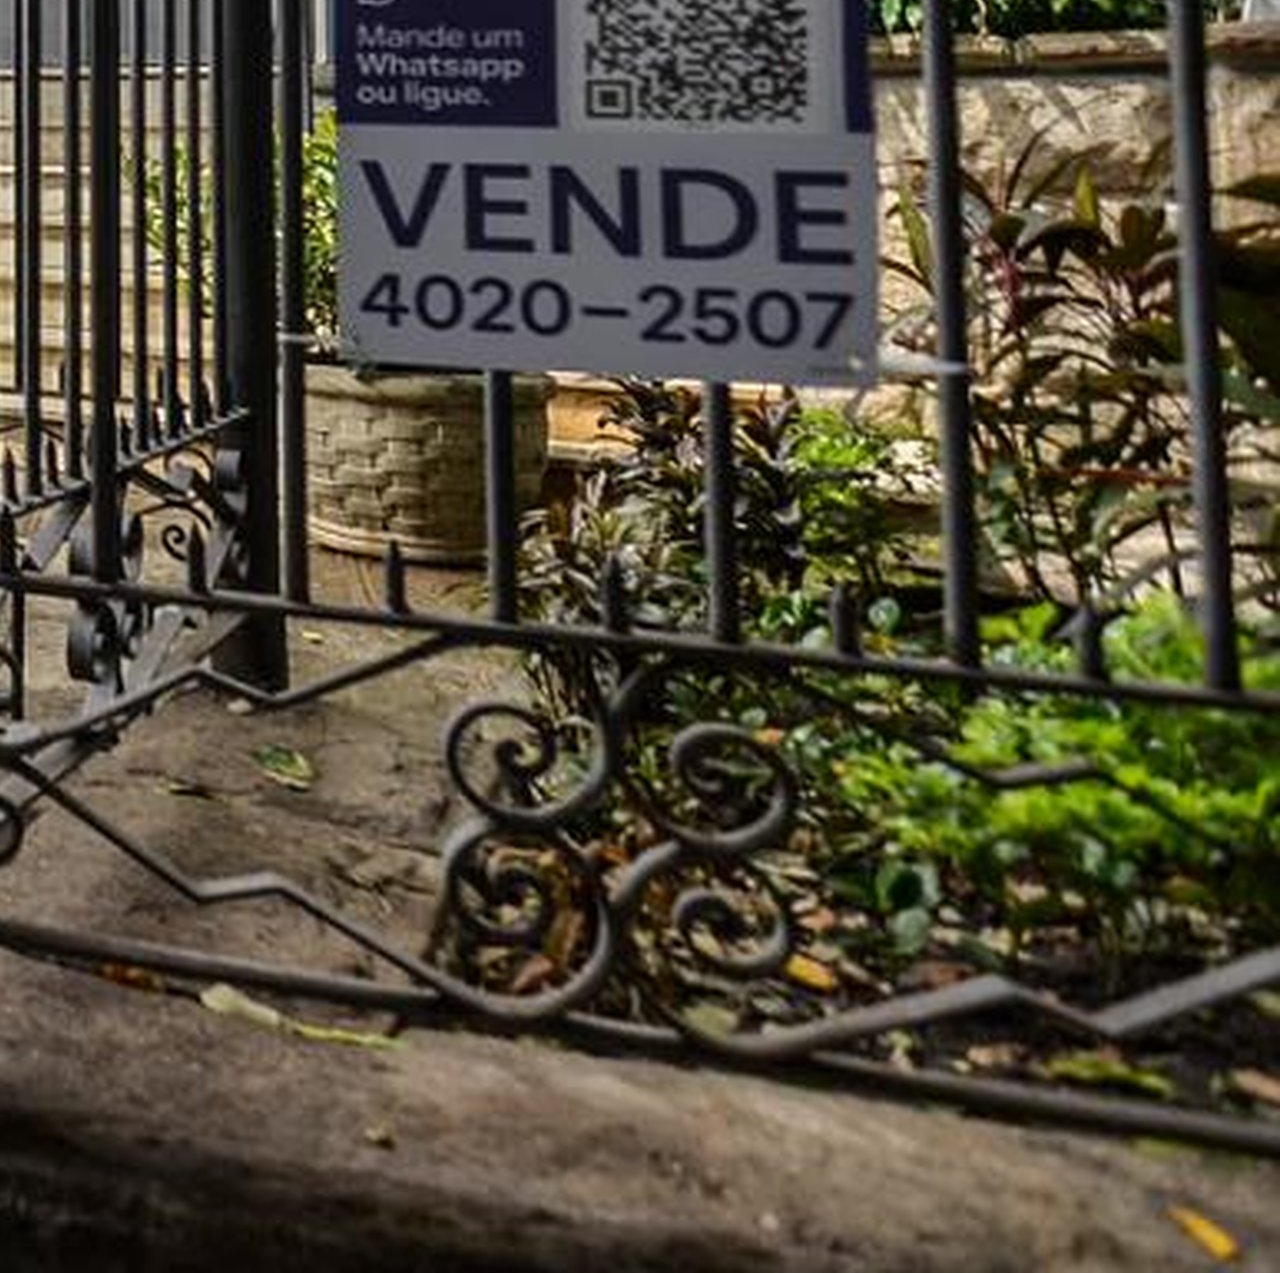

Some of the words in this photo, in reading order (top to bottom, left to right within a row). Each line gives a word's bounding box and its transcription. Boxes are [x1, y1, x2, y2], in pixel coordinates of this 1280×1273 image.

[357, 24, 465, 49] Mande
[472, 29, 525, 49] um
[356, 53, 526, 82] Whatsapp
[356, 85, 397, 105] ou
[404, 80, 492, 111] ligue.
[359, 159, 855, 266] VENDE
[360, 273, 855, 349] 4020-2507
